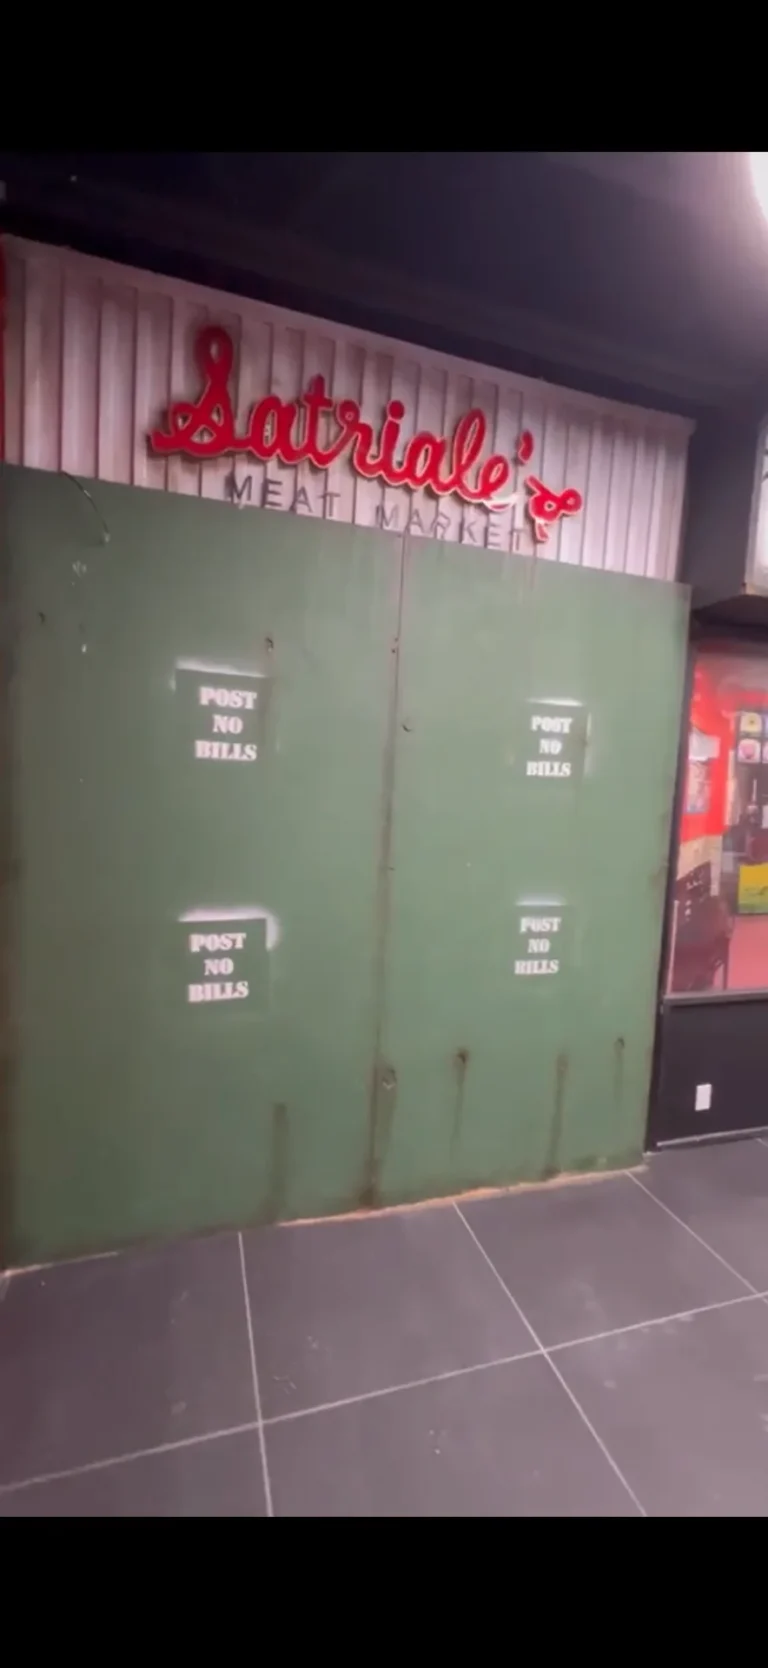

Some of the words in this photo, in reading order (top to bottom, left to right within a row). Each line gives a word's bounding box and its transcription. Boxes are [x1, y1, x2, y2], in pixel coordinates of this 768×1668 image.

[150, 325, 583, 542] Satriale's
[227, 473, 341, 520] MEAT
[375, 503, 526, 551] MARKET
[199, 686, 257, 710] POST
[212, 714, 243, 735] NO
[530, 715, 572, 734] POST
[194, 740, 258, 761] BILLS
[538, 738, 562, 756] NO
[525, 760, 572, 778] BILLS
[519, 916, 561, 933] POST
[189, 933, 246, 952] POST
[527, 938, 550, 954] NO
[203, 957, 234, 977] NO
[513, 959, 559, 975] BILLS
[187, 981, 249, 1003] BILLS
